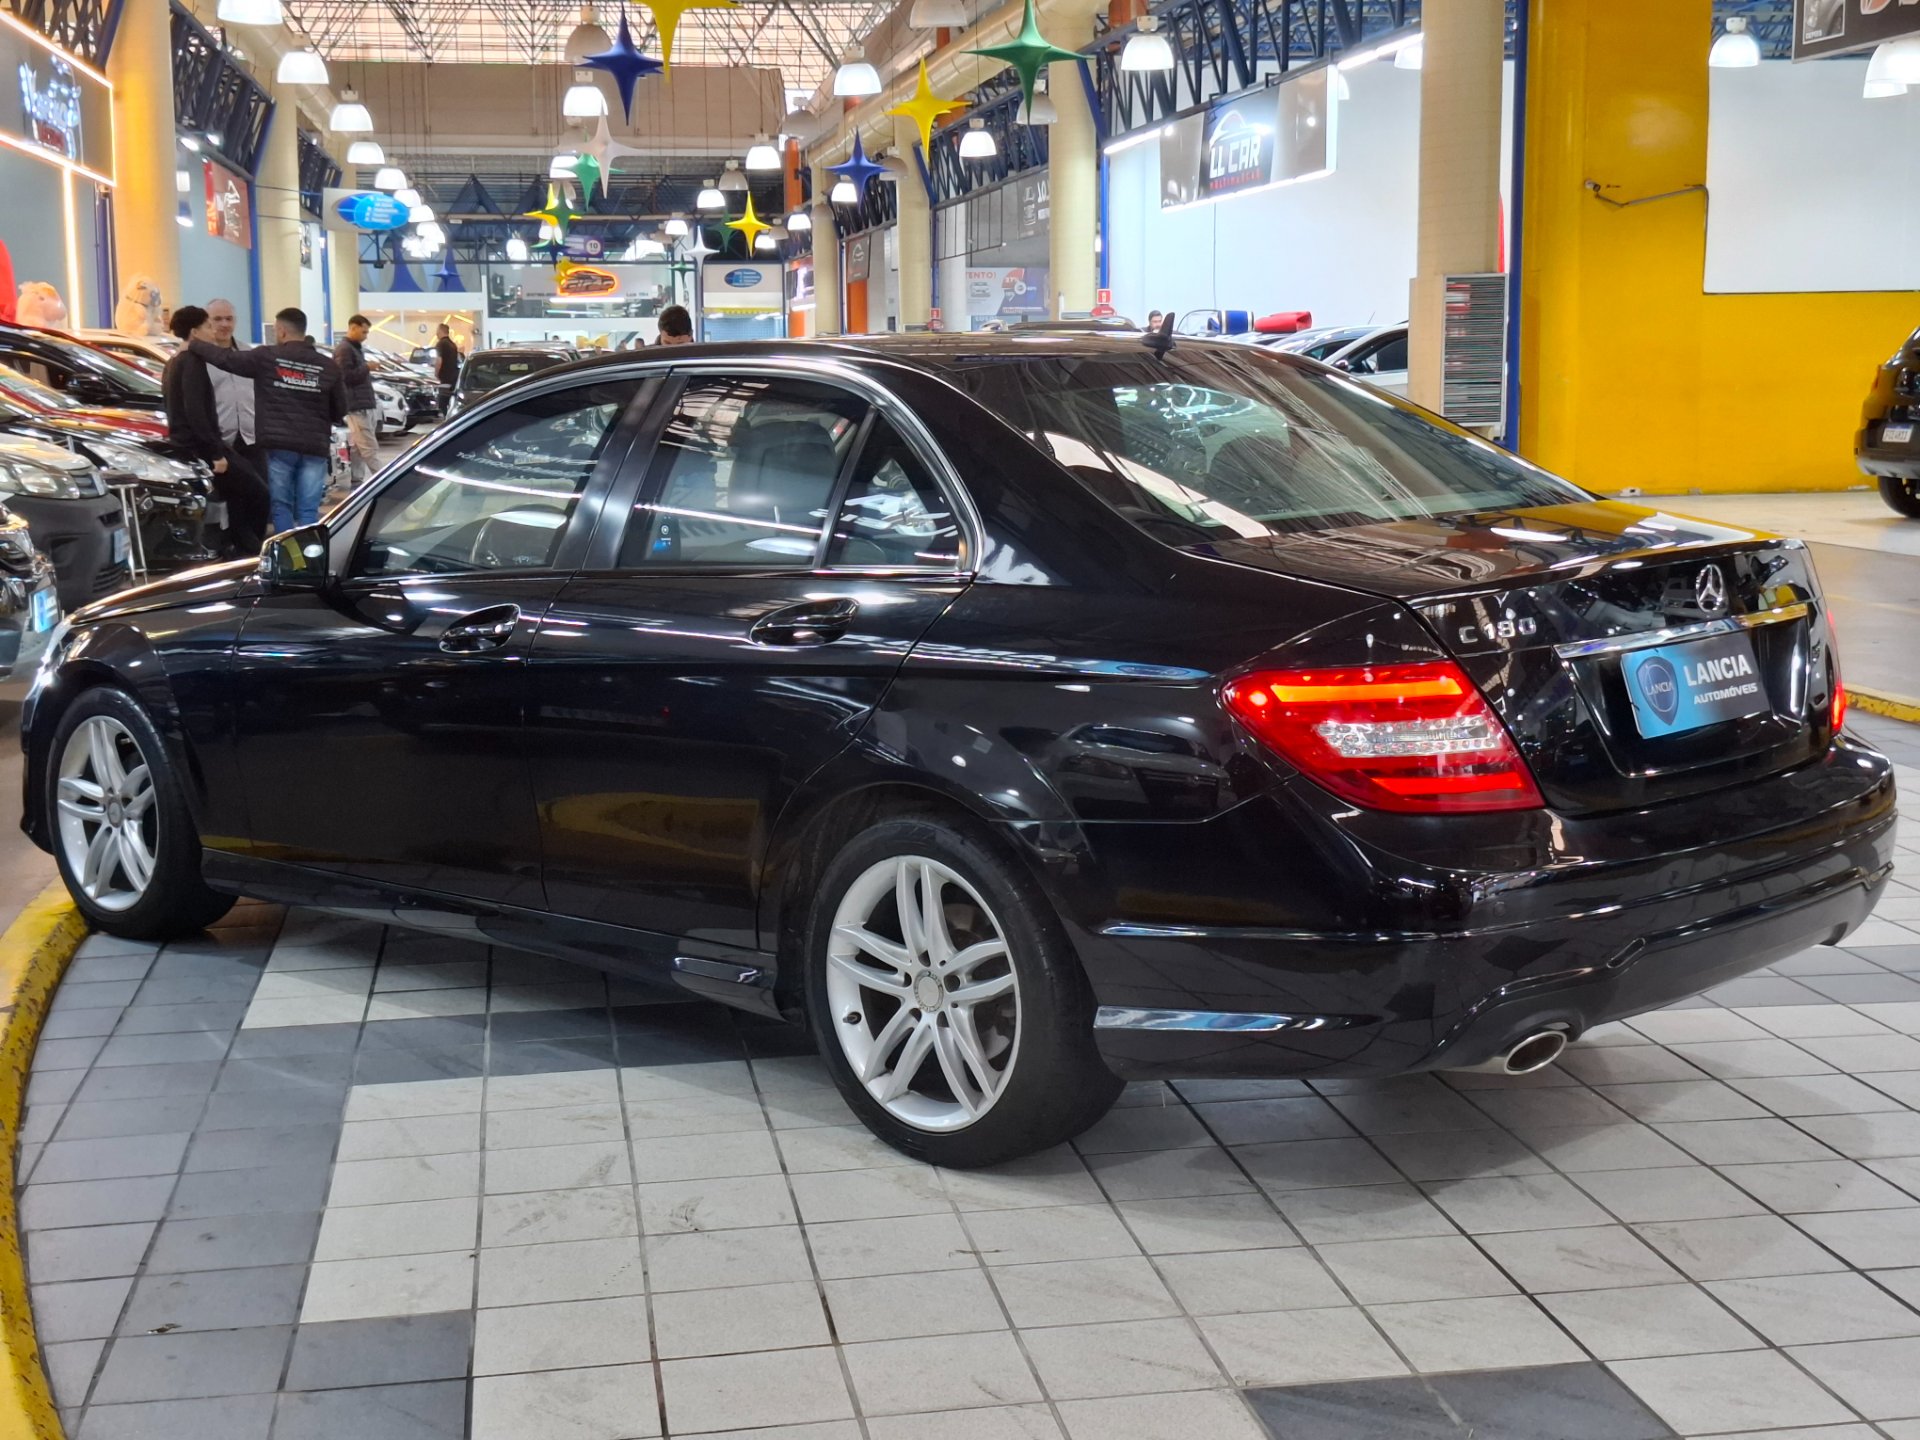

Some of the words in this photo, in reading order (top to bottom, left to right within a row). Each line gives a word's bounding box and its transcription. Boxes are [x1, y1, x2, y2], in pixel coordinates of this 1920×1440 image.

[1228, 135, 1261, 174] CAR
[1683, 654, 1752, 687] LANCIA
[1645, 681, 1673, 696] LANCIA
[1693, 682, 1759, 705] AUTOMÓVEIS
